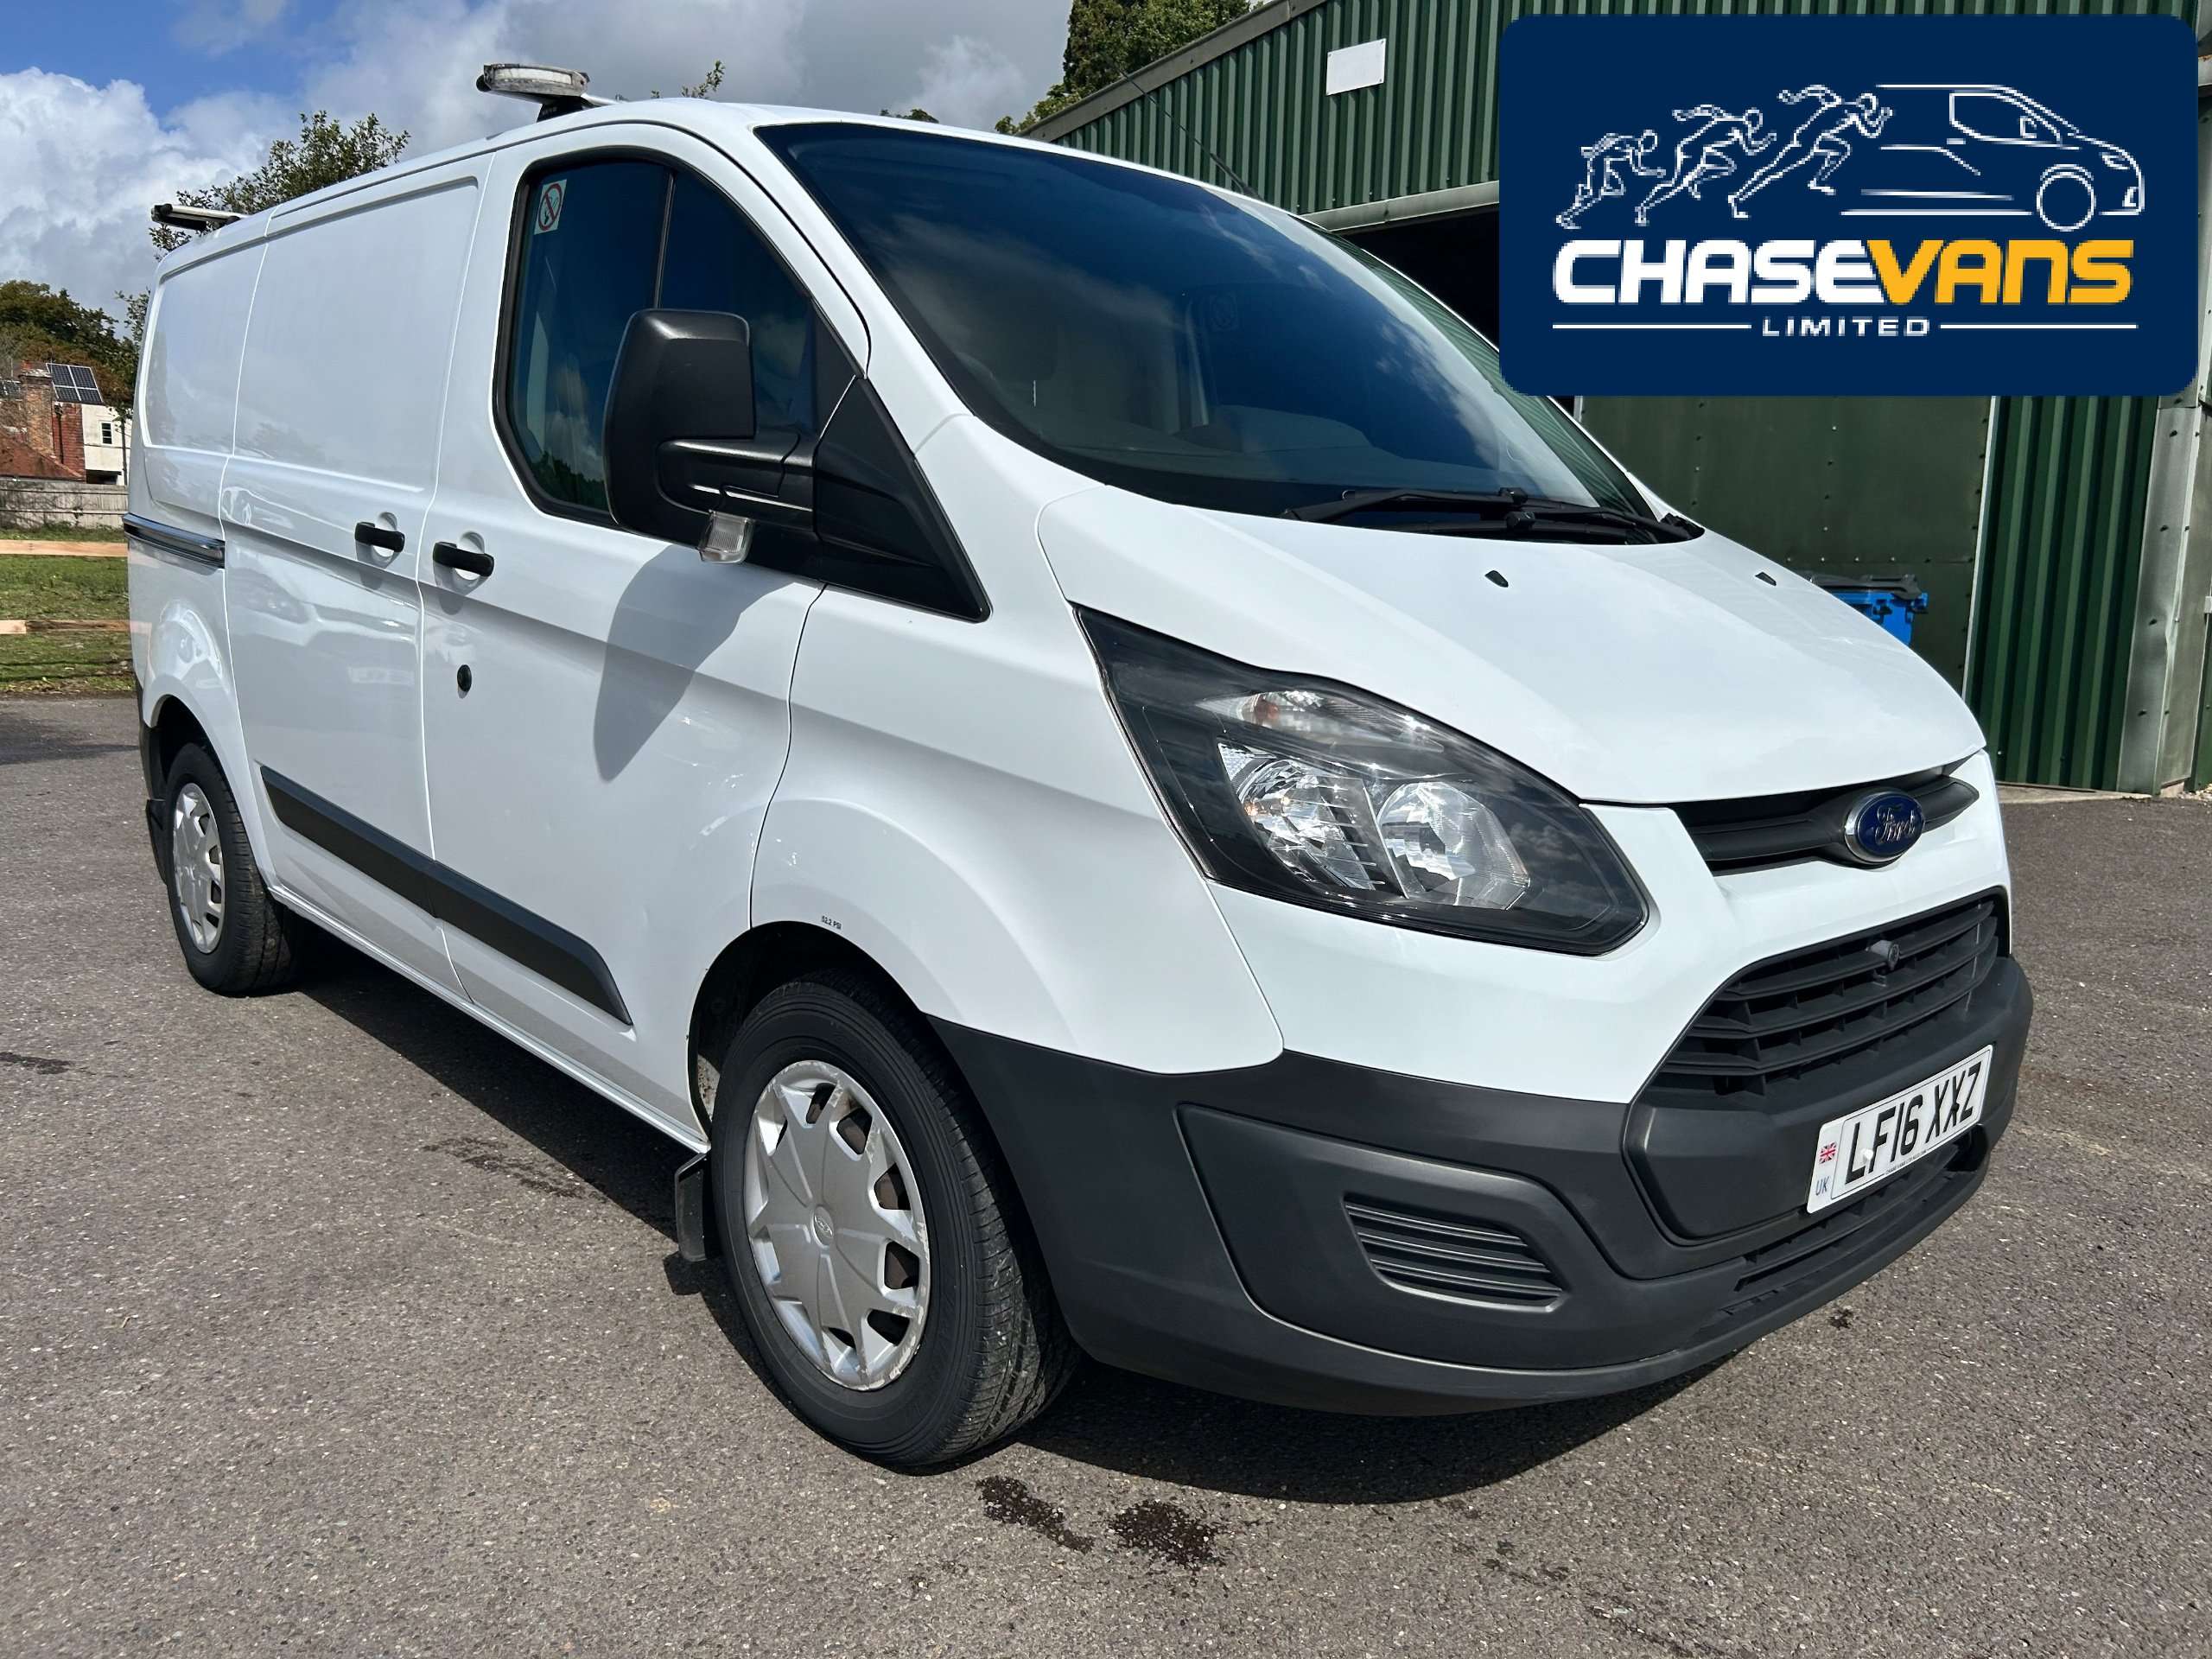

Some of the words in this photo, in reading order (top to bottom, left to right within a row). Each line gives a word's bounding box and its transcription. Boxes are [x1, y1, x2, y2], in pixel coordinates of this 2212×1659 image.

[1875, 804, 1916, 845] Ford
[1845, 1094, 1923, 1185] LF16
[1925, 1060, 1982, 1144] XXZ
[1815, 1175, 1830, 1196] UK
